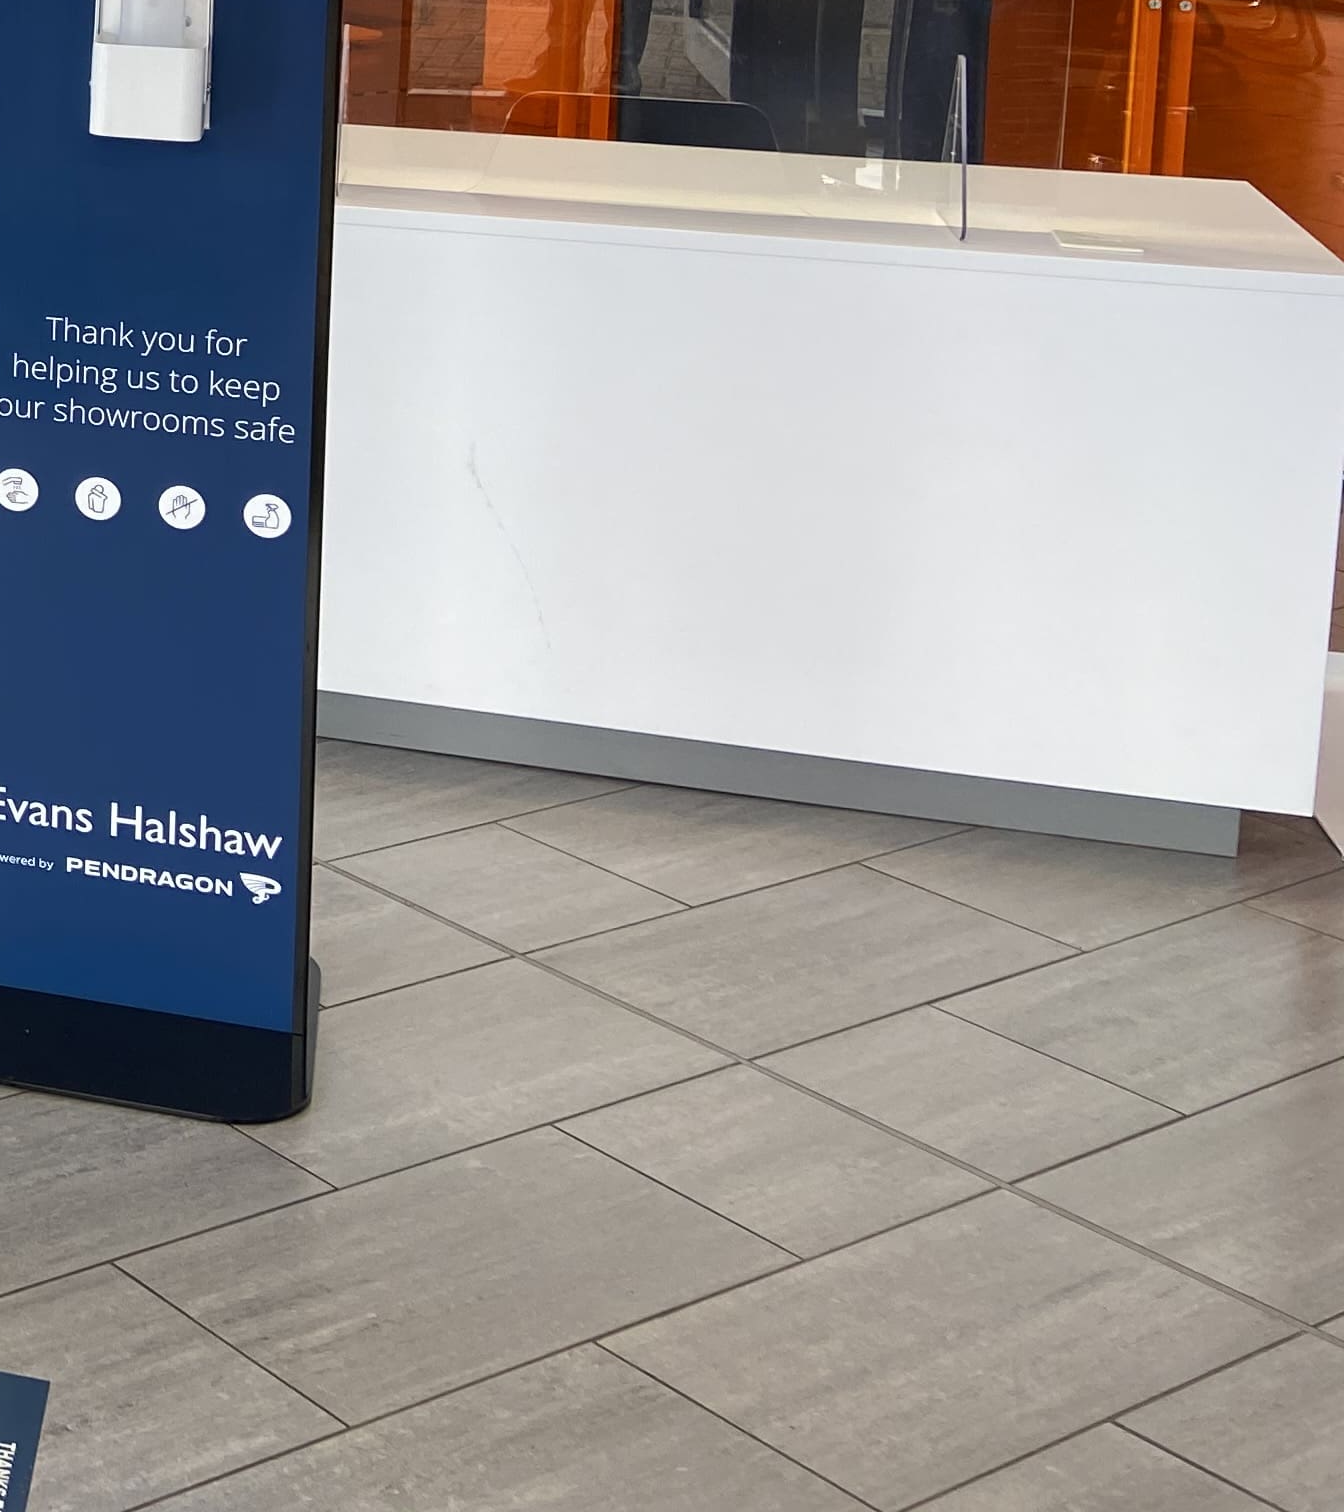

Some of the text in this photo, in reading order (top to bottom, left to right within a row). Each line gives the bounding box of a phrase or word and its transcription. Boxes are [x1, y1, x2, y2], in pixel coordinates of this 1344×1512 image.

[46, 316, 248, 357] Thank you for
[13, 352, 280, 408] helping us to keep
[53, 398, 225, 437] showrooms
[234, 416, 296, 444] safe
[110, 802, 283, 860] Halshaw
[38, 858, 54, 871] by
[66, 856, 233, 897] PENDRAGON
